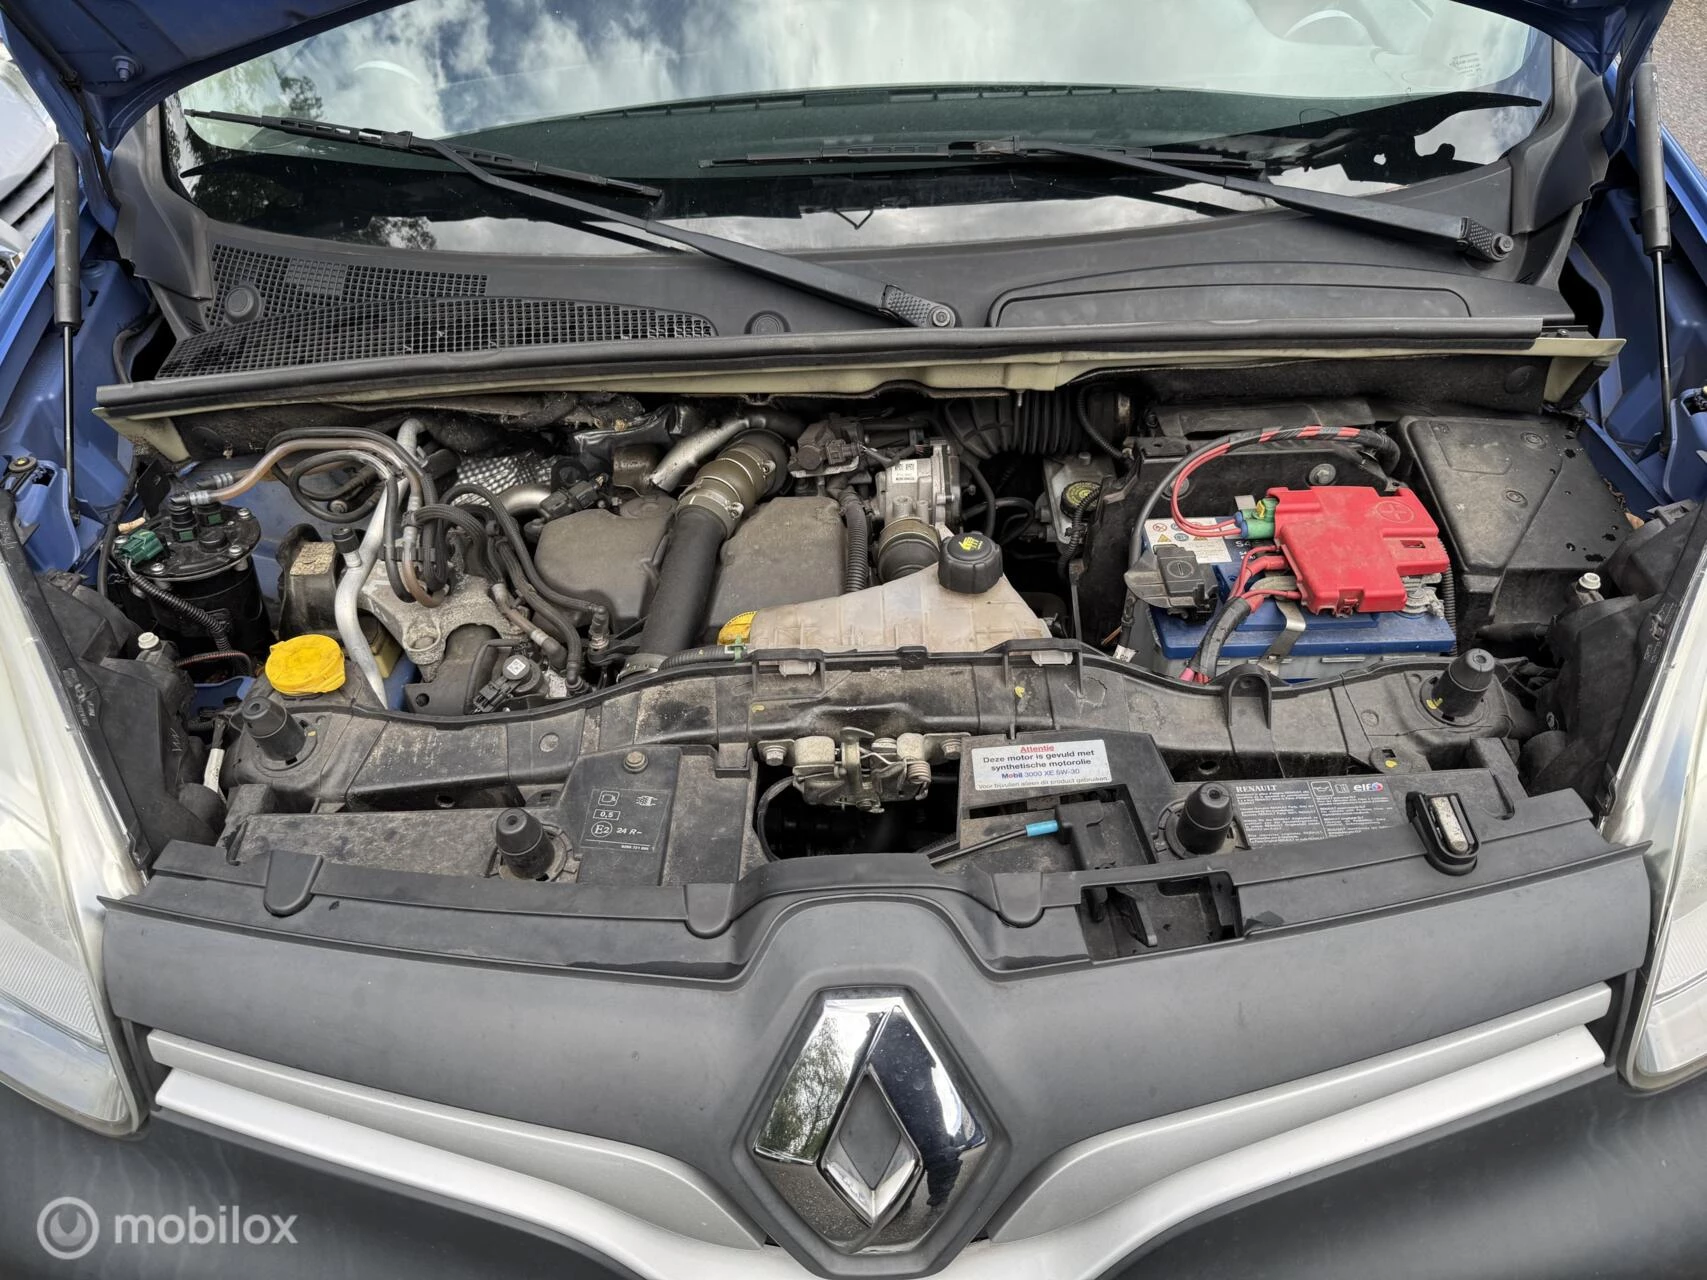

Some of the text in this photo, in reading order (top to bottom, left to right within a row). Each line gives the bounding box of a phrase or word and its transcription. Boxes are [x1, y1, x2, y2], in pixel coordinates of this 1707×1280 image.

[1020, 745, 1055, 753] Attentie
[1007, 754, 1034, 762] motor
[1046, 751, 1075, 760] gevuld
[991, 758, 1092, 771] synthetische motorolie
[1236, 784, 1277, 793] RENAULT
[1353, 783, 1373, 792] elf
[594, 824, 610, 835] E2
